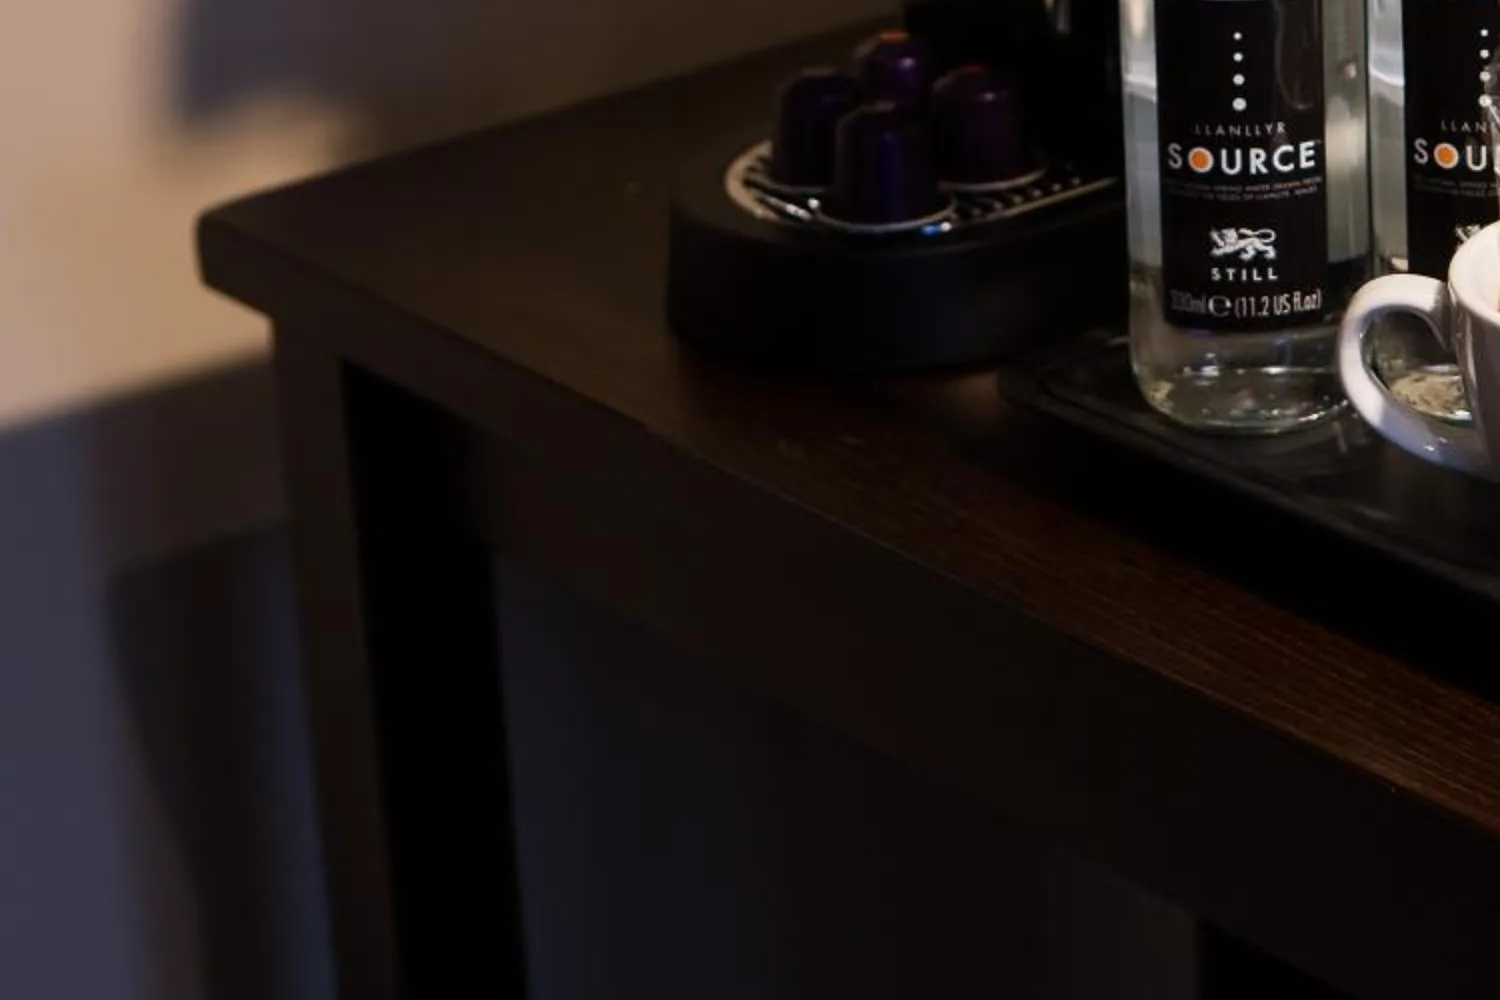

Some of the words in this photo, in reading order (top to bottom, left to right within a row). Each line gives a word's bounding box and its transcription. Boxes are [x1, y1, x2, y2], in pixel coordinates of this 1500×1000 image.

[1191, 121, 1286, 137] LLANLLYR
[1167, 141, 1316, 175] SOURCE
[1210, 267, 1279, 281] STILL
[1273, 294, 1291, 316] US
